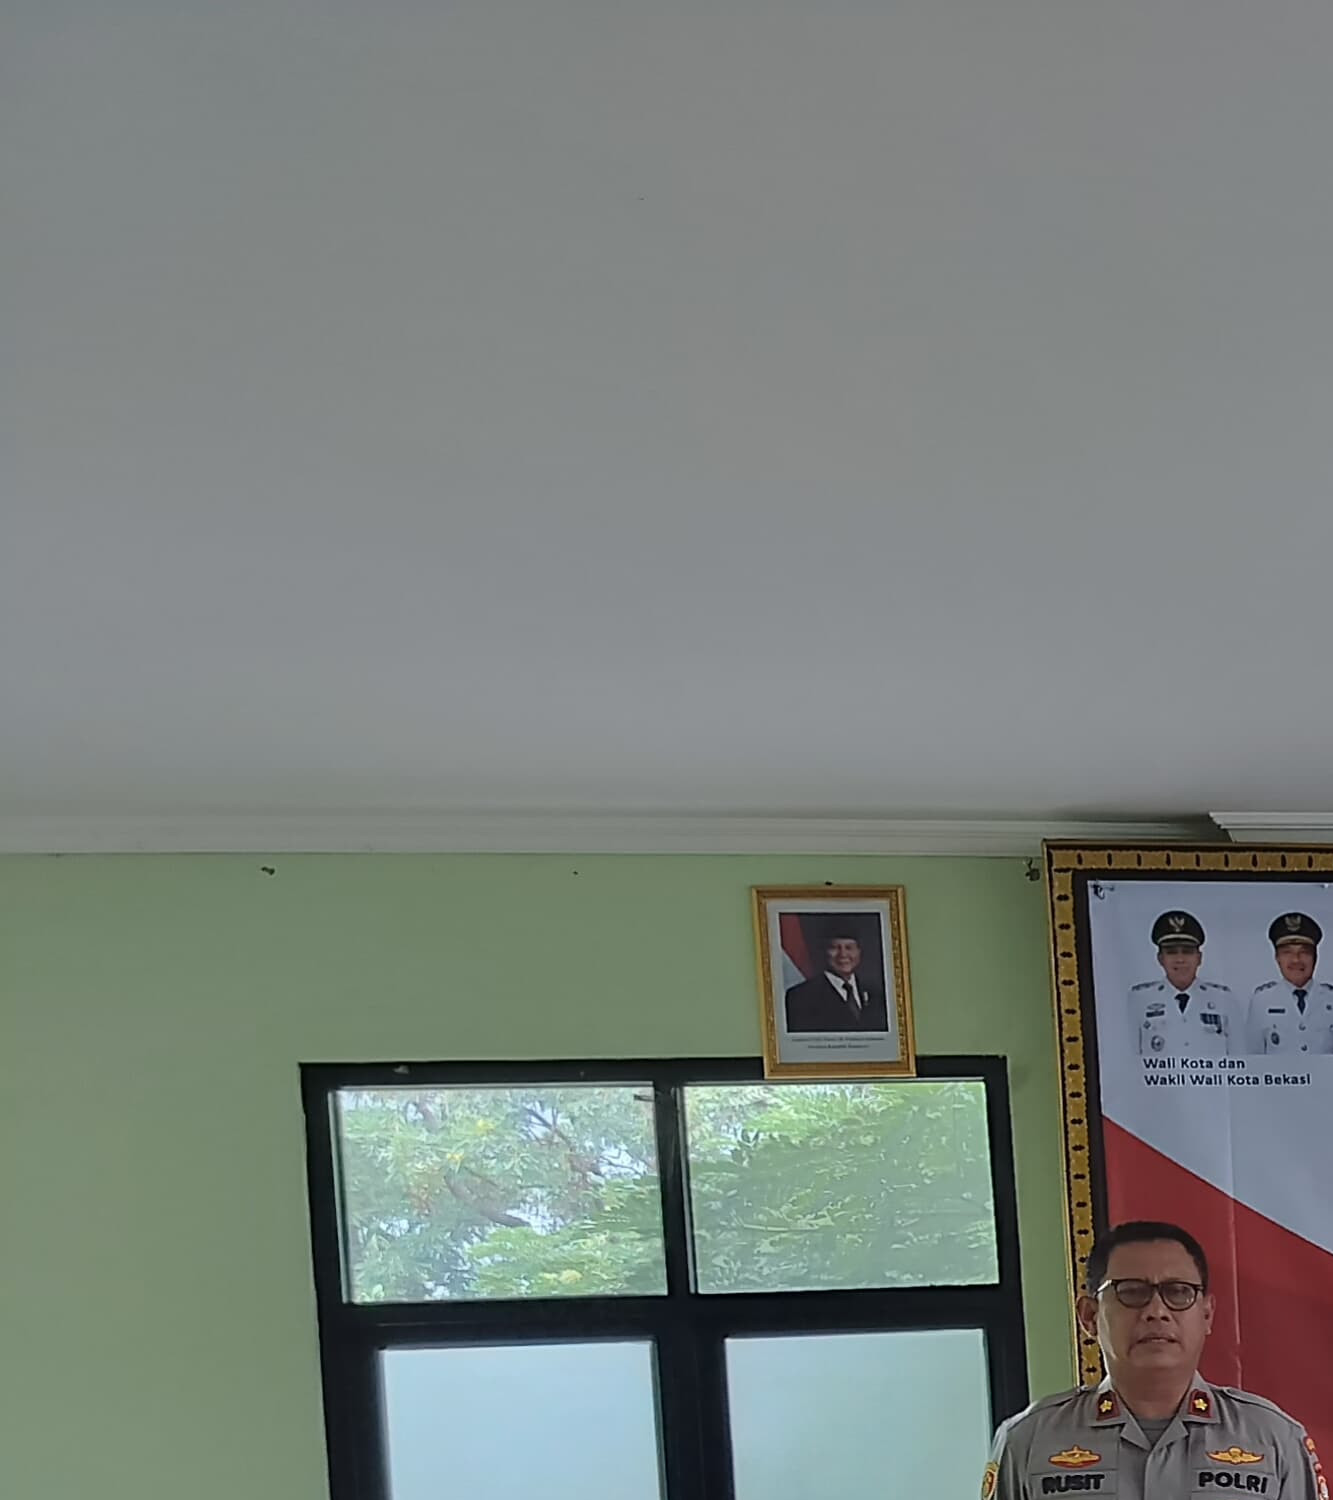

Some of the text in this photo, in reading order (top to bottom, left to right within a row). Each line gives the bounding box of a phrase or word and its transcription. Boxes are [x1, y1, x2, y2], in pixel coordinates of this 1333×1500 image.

[1143, 1057, 1245, 1069] Wali Kota dan
[1144, 1073, 1311, 1086] Wakil Wali Kota Bekasi
[1197, 1471, 1269, 1494] POLRI
